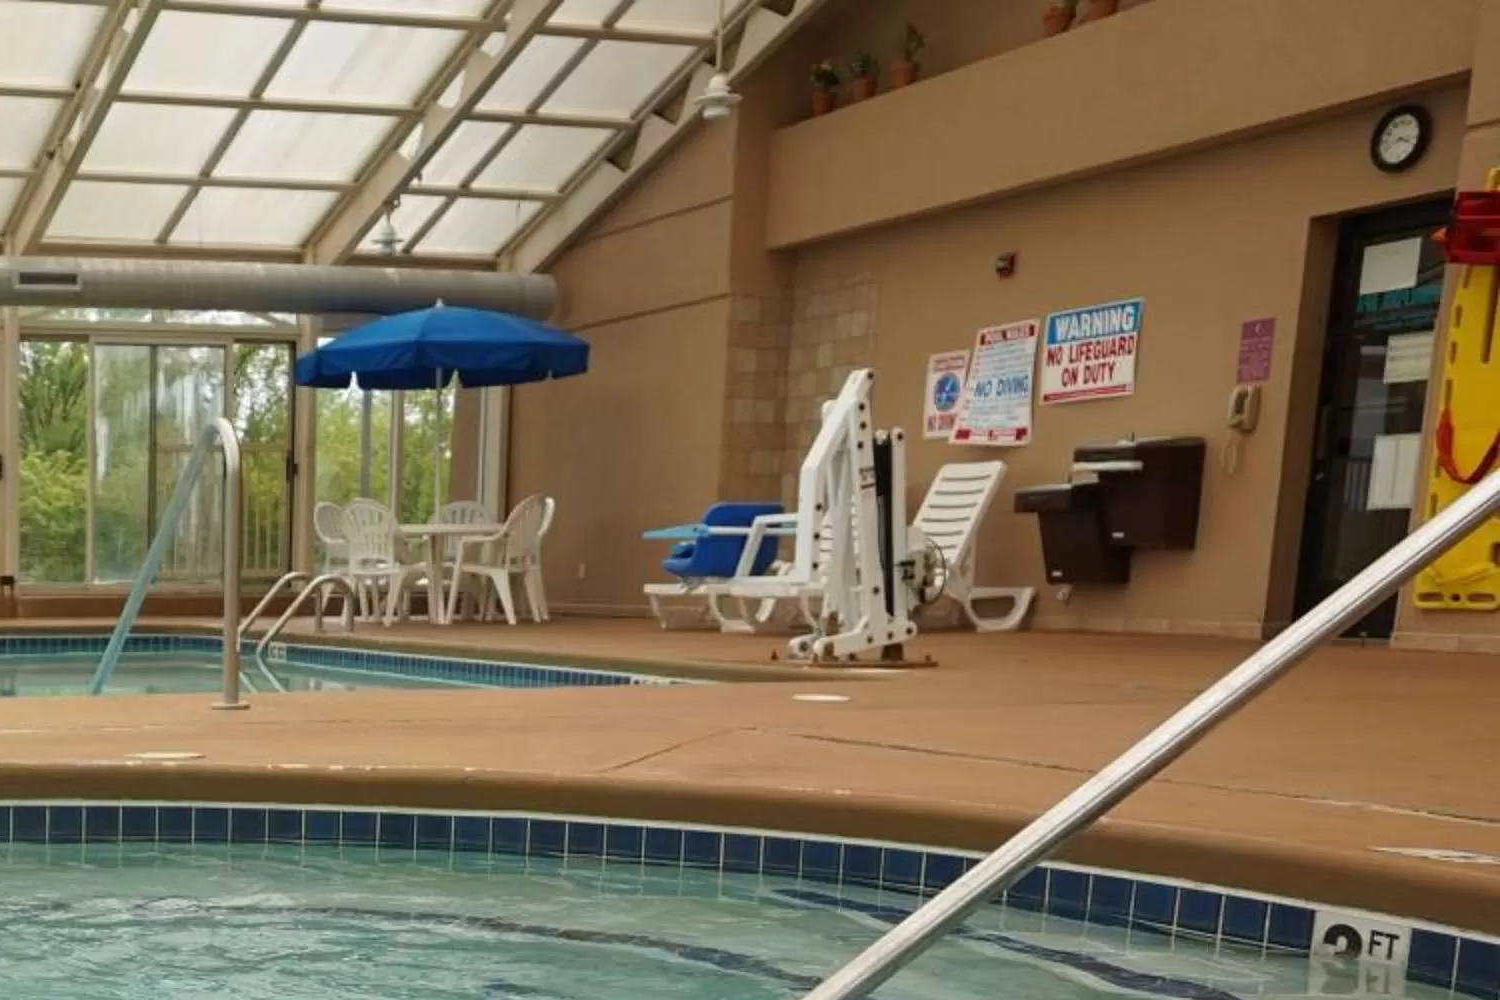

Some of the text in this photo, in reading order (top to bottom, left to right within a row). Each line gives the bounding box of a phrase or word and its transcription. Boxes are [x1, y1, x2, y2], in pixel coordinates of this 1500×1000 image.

[1055, 304, 1136, 341] WARNING
[1046, 345, 1063, 368] NO
[1068, 335, 1135, 363] LIFEGUARD
[975, 379, 993, 398] NO
[996, 374, 1029, 397] DIVING
[1061, 360, 1116, 387] ON DUTY
[1368, 929, 1400, 960] FT
